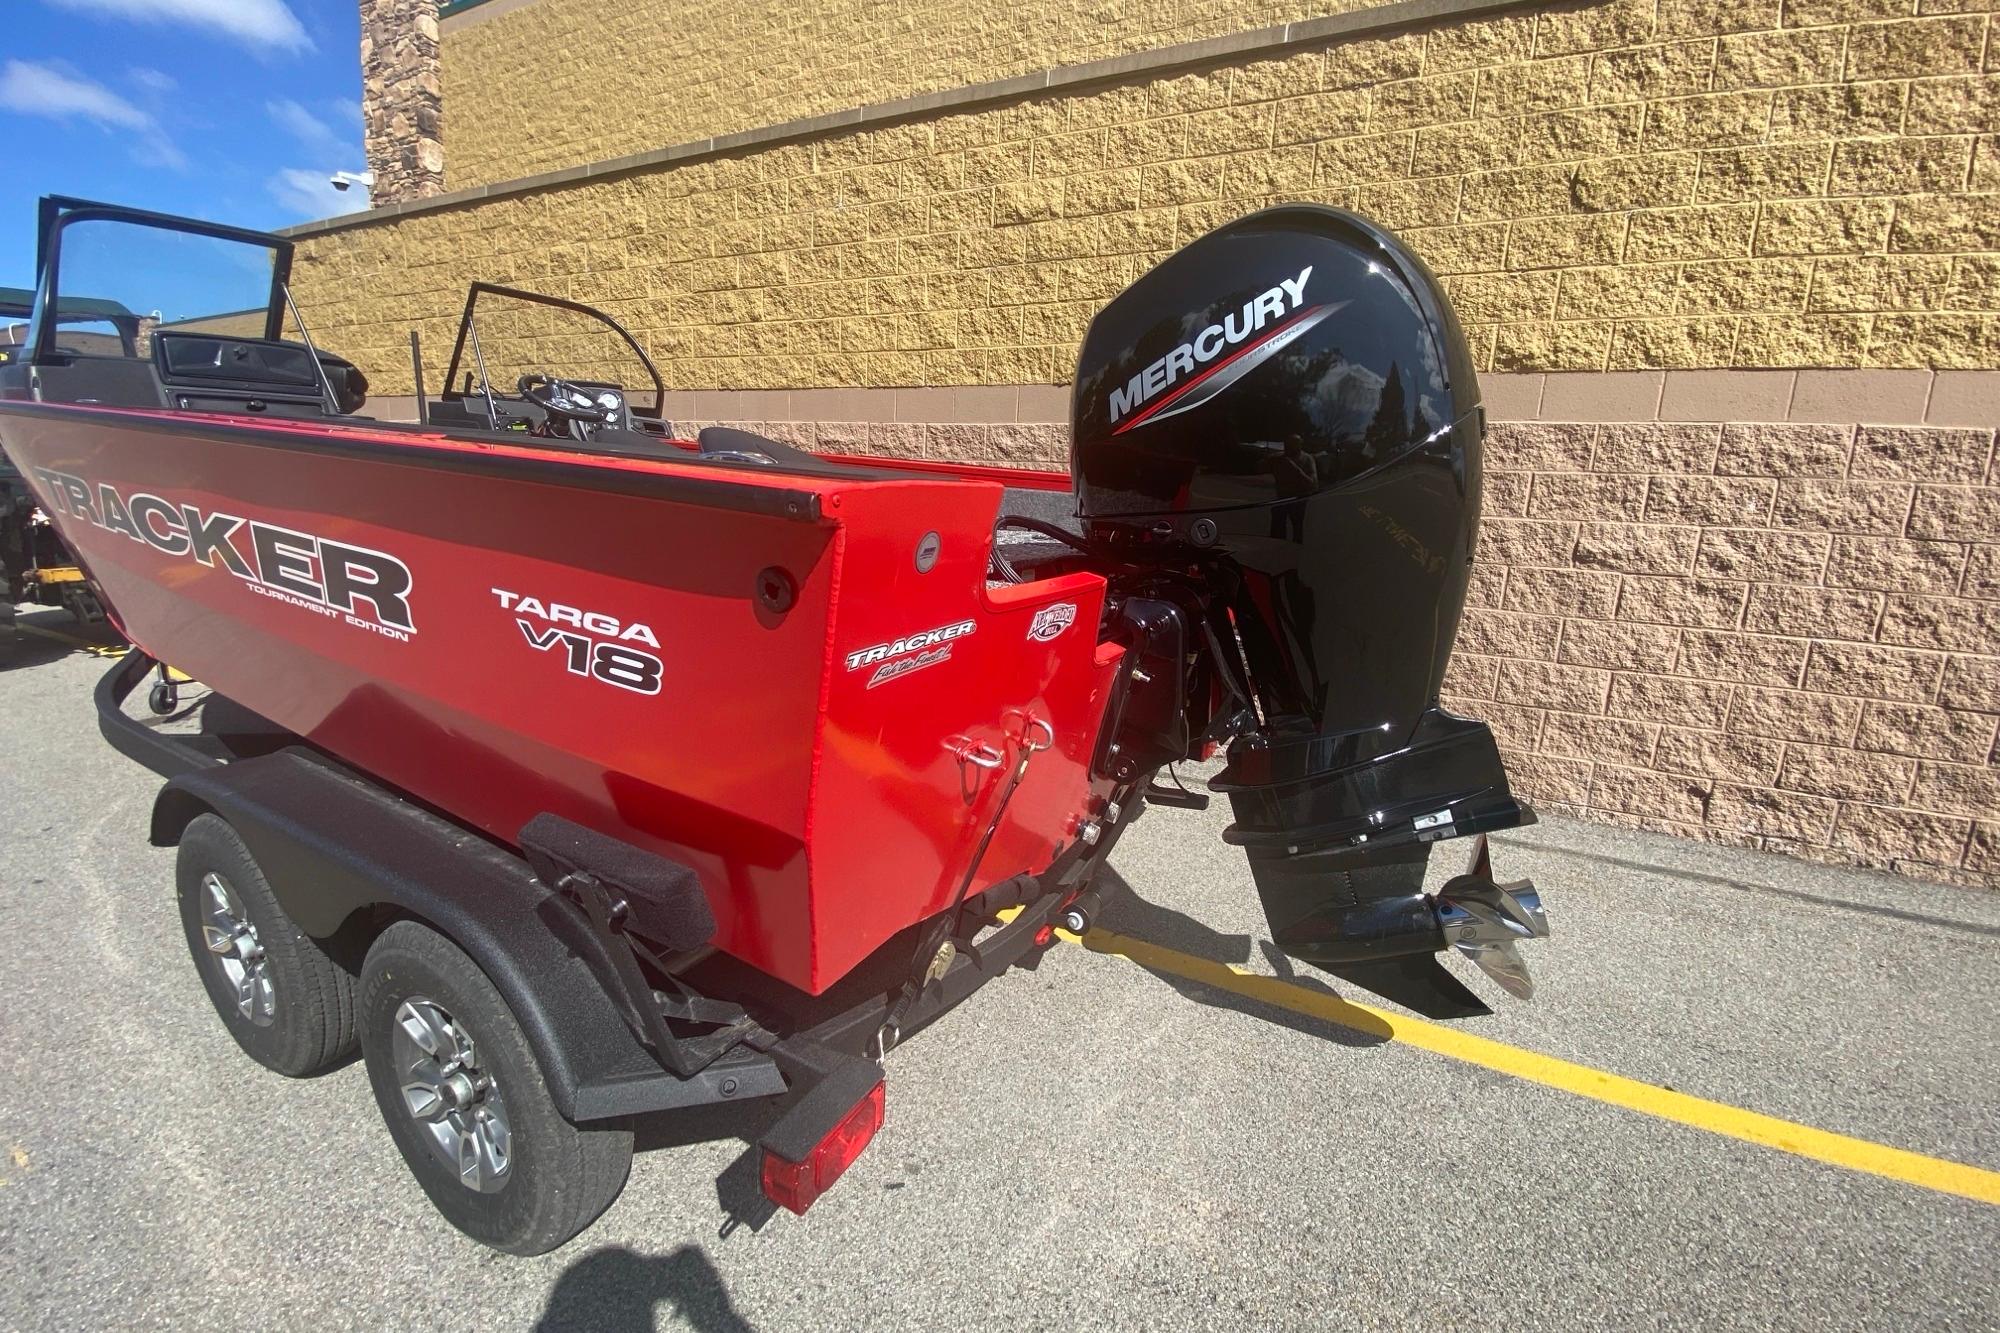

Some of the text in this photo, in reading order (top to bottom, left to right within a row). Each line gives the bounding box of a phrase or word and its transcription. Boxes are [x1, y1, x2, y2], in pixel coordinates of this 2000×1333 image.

[1109, 265, 1313, 424] MERCURY
[34, 465, 418, 634] TRACKER
[246, 581, 410, 643] TOURNAMENT EDITION
[491, 587, 662, 649] TARGA
[847, 620, 975, 671] TRACKER
[516, 617, 664, 696] V18
